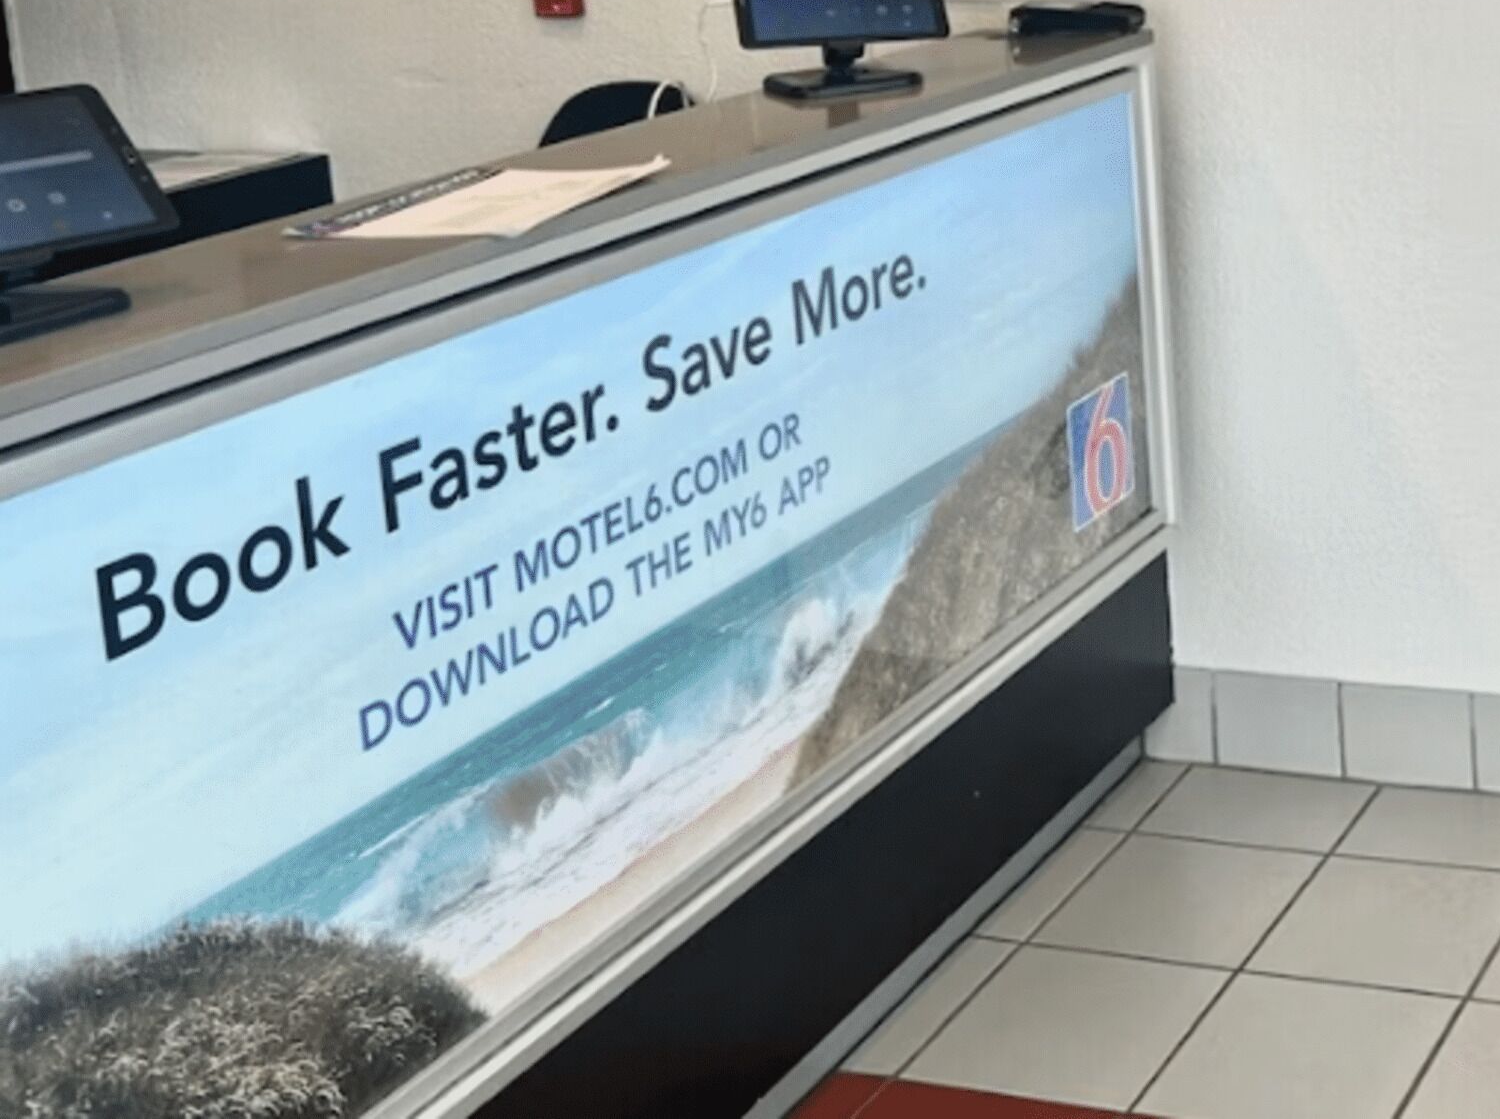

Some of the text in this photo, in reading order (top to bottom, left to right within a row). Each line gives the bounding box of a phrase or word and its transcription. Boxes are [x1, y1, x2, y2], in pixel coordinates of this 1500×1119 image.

[96, 254, 926, 662] Book Faster. Save More.
[392, 412, 802, 650] VISIT MOTEL6.COM OR
[1084, 383, 1127, 516] 6
[359, 455, 832, 752] DOWNLOAD THE MY6 APP
